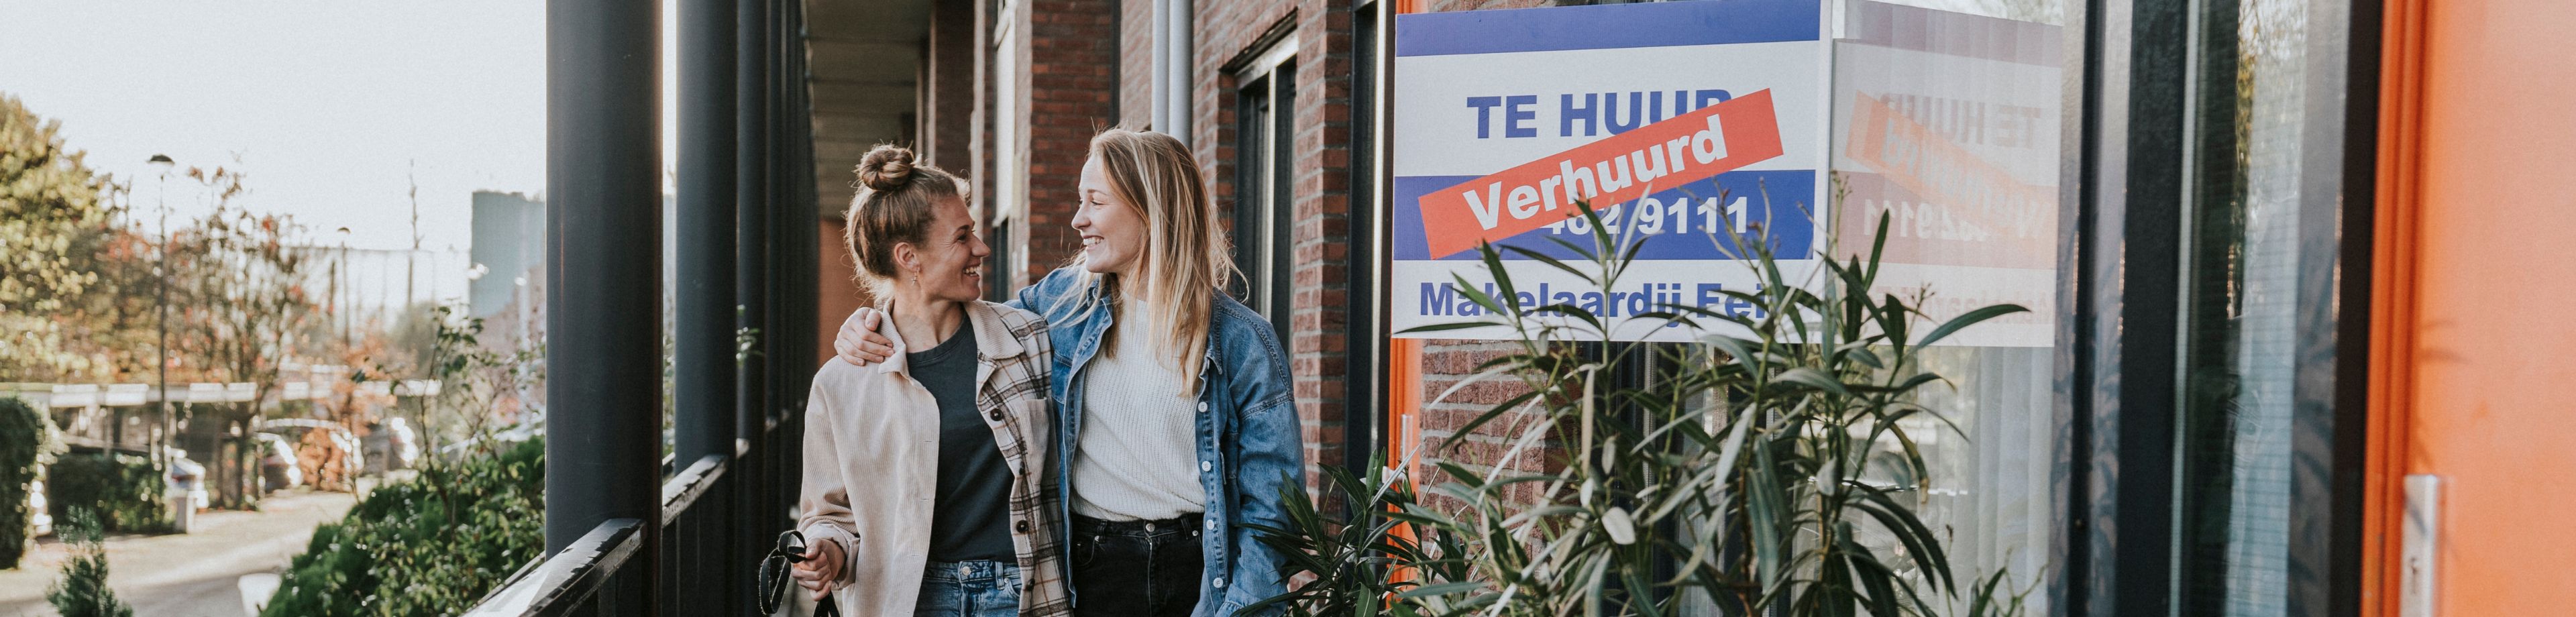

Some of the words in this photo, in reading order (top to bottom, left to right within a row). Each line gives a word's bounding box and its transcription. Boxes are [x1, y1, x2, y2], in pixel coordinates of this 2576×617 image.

[1466, 95, 1538, 139] TE
[1462, 113, 1729, 231] Verhuurd
[1638, 197, 1748, 235] 9111
[1420, 282, 1681, 328] Makelaardij
